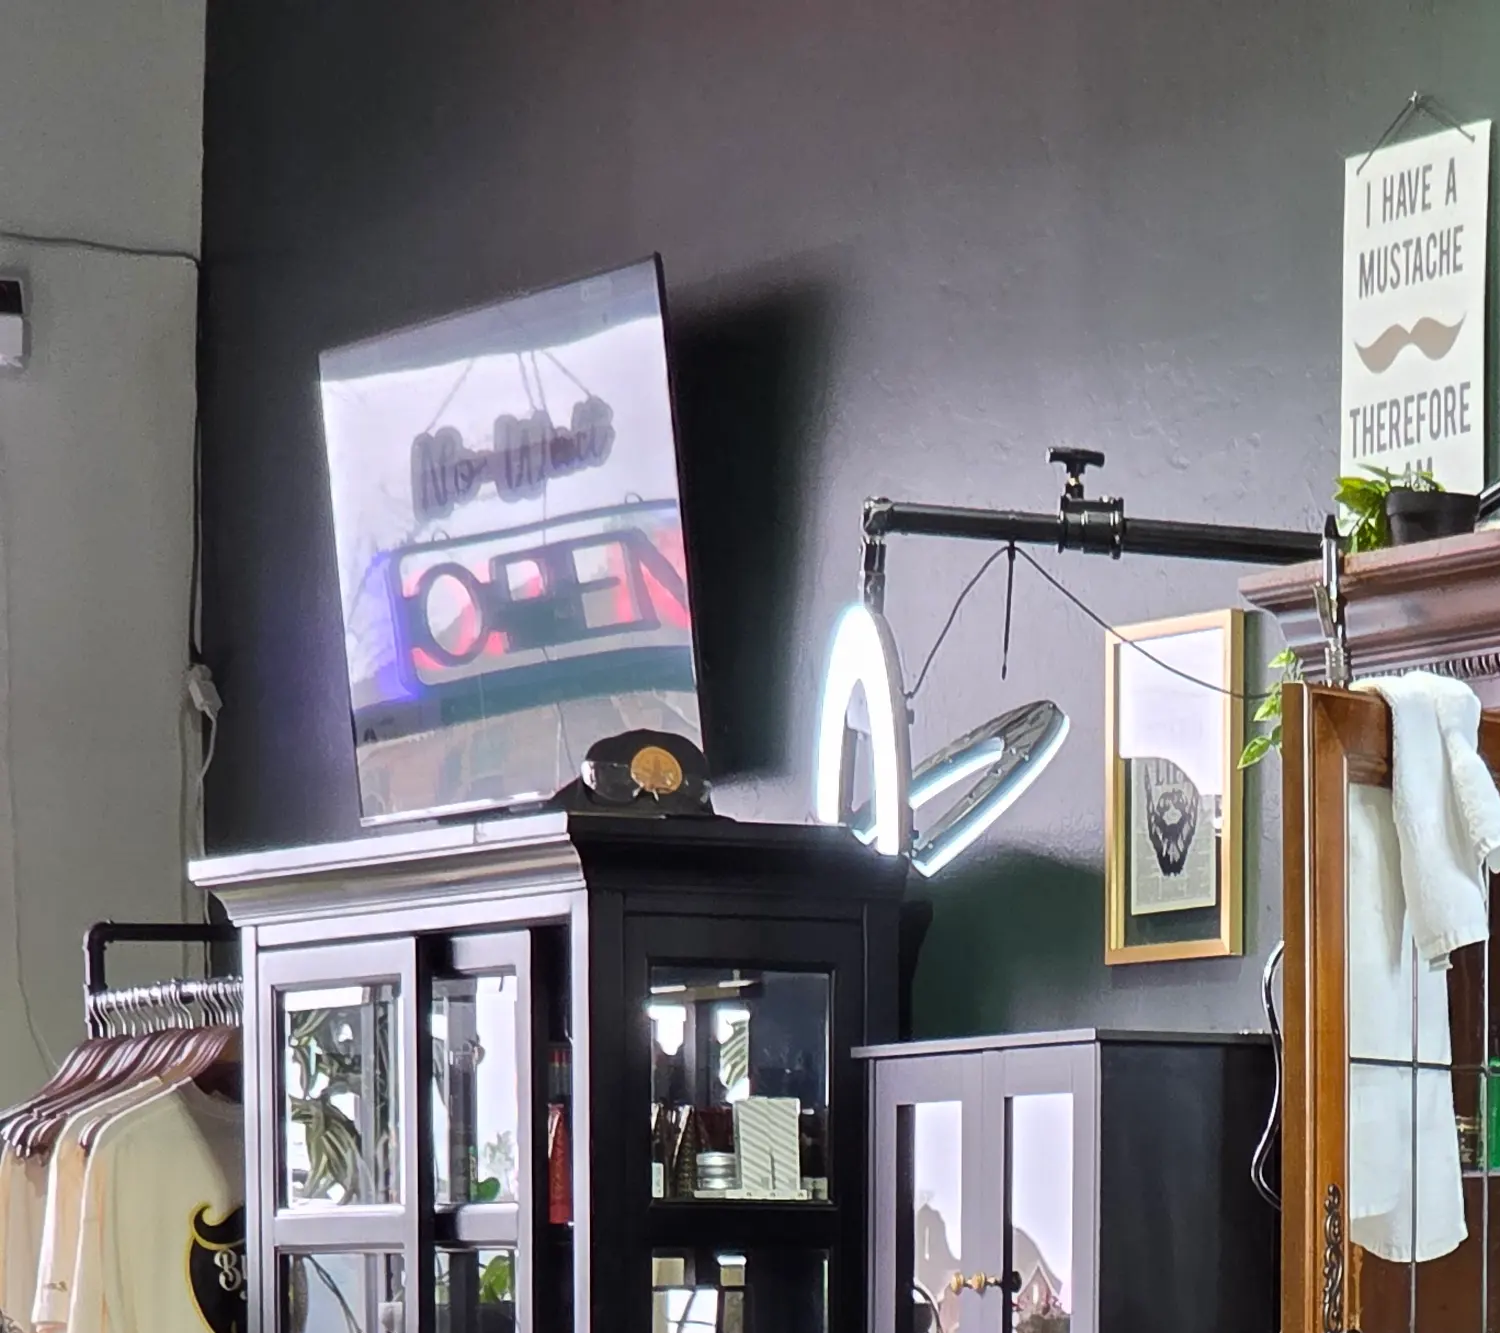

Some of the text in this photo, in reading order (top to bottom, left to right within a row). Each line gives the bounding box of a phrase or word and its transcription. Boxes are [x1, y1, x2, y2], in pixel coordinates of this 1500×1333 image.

[1365, 156, 1458, 229] I HAVE A
[1358, 224, 1465, 301] MUSTACHE
[1349, 381, 1471, 459] THEREFORE
[408, 525, 693, 668] OPEN
